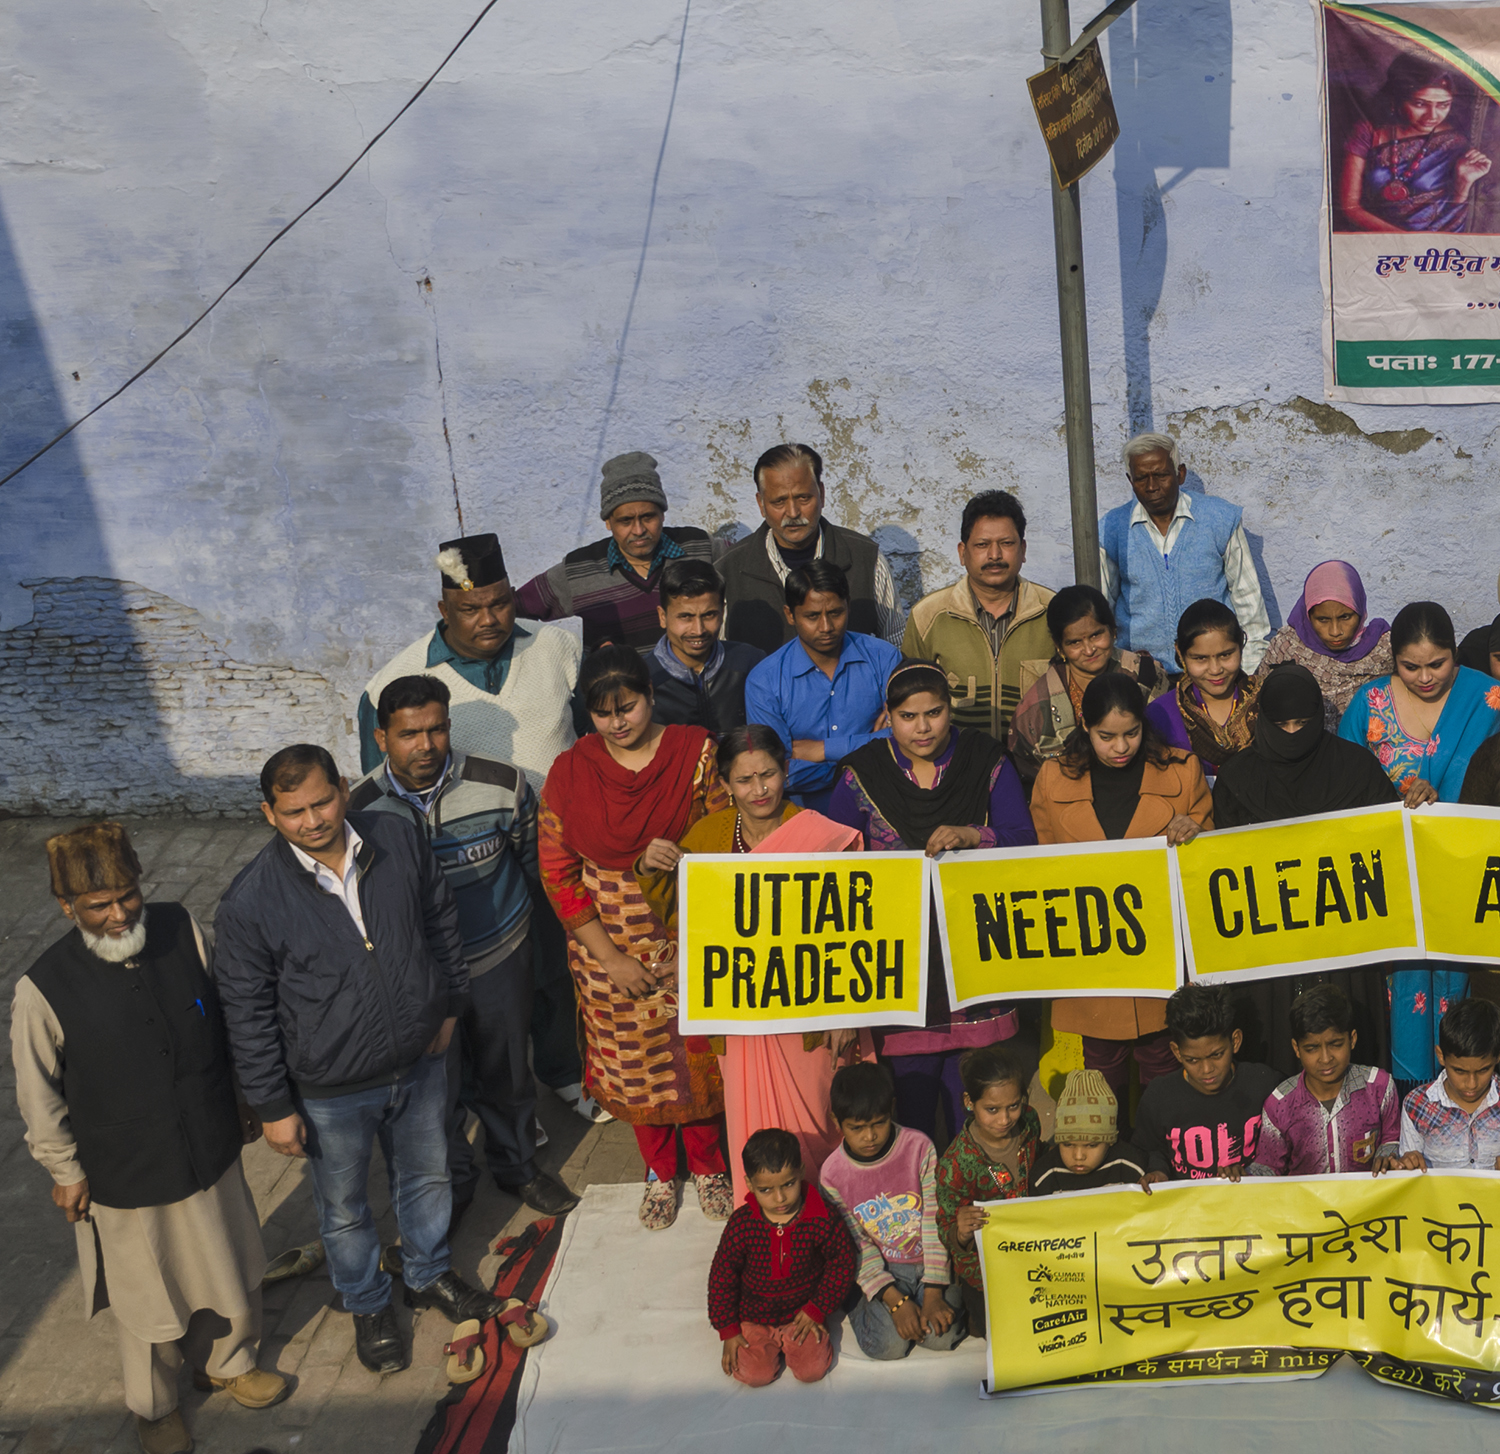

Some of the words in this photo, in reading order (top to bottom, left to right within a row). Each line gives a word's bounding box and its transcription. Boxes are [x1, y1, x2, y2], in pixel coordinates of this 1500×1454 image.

[1375, 255, 1408, 277] हर
[1414, 248, 1488, 277] पीड़ित
[734, 871, 874, 938] UTTAR
[1208, 849, 1389, 939] CLEAN
[972, 883, 1147, 962] NEEDS
[703, 939, 904, 1009] PRADESH
[997, 1236, 1086, 1252] GREENPEACE
[1127, 1235, 1261, 1285] उत्तर
[1277, 1210, 1408, 1267] प्रदेश
[1422, 1203, 1493, 1267] को
[1034, 1311, 1086, 1331] Care4Air
[1045, 1299, 1083, 1308] NATION
[1103, 1288, 1258, 1337] स्वच्छ
[1274, 1276, 1371, 1331] हवा
[1067, 1331, 1087, 1346] 2025
[1136, 1358, 1158, 1375] के
[1168, 1351, 1241, 1373] समर्थन
[1251, 1350, 1270, 1369] में
[1378, 1363, 1424, 1386] call
[1432, 1368, 1467, 1394] करें
